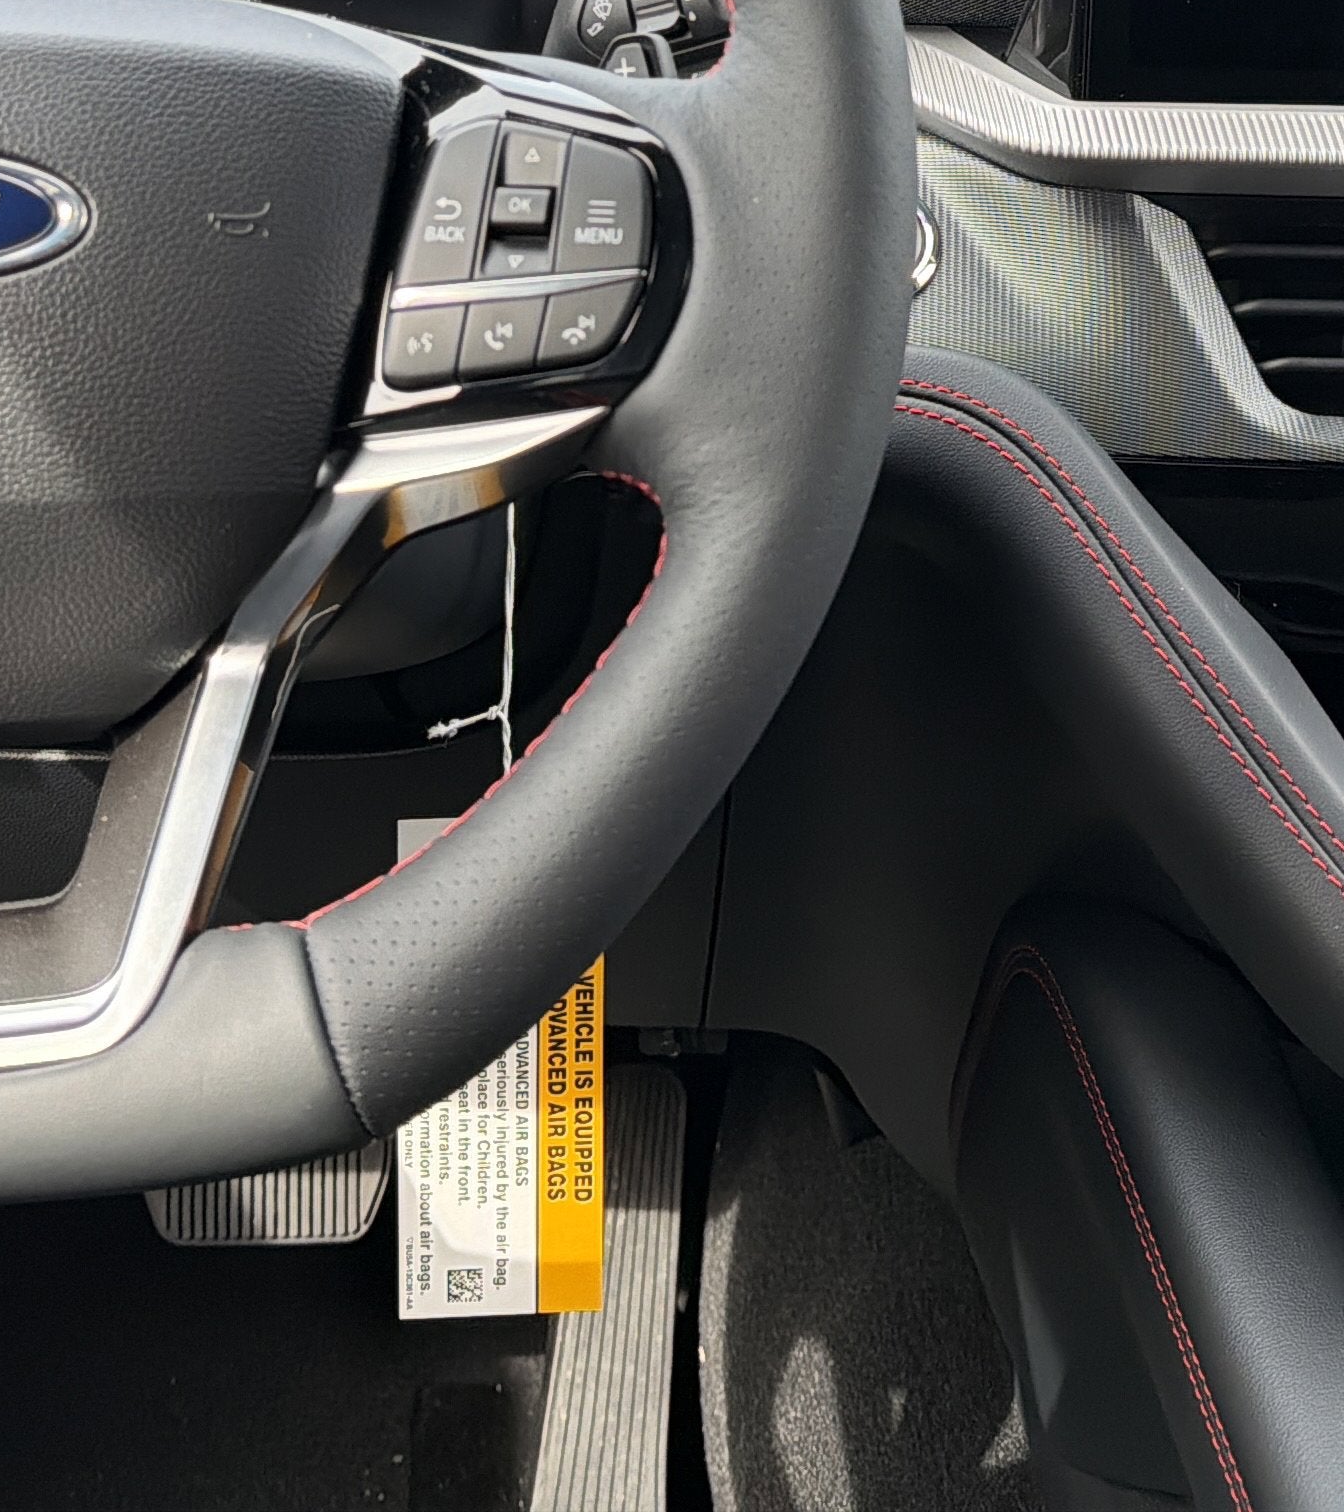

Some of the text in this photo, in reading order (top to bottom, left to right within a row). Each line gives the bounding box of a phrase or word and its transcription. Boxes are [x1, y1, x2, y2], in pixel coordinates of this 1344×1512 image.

[508, 196, 532, 213] OK
[424, 226, 465, 243] BACK
[574, 227, 624, 245] MENU
[494, 1053, 509, 1120] seriously
[548, 999, 566, 1200] DVANCED AIR BAGS
[574, 975, 595, 1201] VEHICLE IS EQUIPPED
[458, 1119, 471, 1132] in
[477, 1115, 490, 1135] for
[515, 1116, 529, 1140] AIR
[404, 1140, 413, 1168] ONLY
[439, 1108, 452, 1185] restraints.
[458, 1137, 471, 1161] the
[477, 1140, 490, 1209] Children.
[515, 1147, 529, 1186] BAGS
[458, 1166, 471, 1206] front.
[494, 1183, 509, 1201] by
[417, 1112, 432, 1295] ormation about air bags.
[496, 1207, 509, 1229] the
[496, 1235, 509, 1253] air
[494, 1259, 509, 1290] bag.
